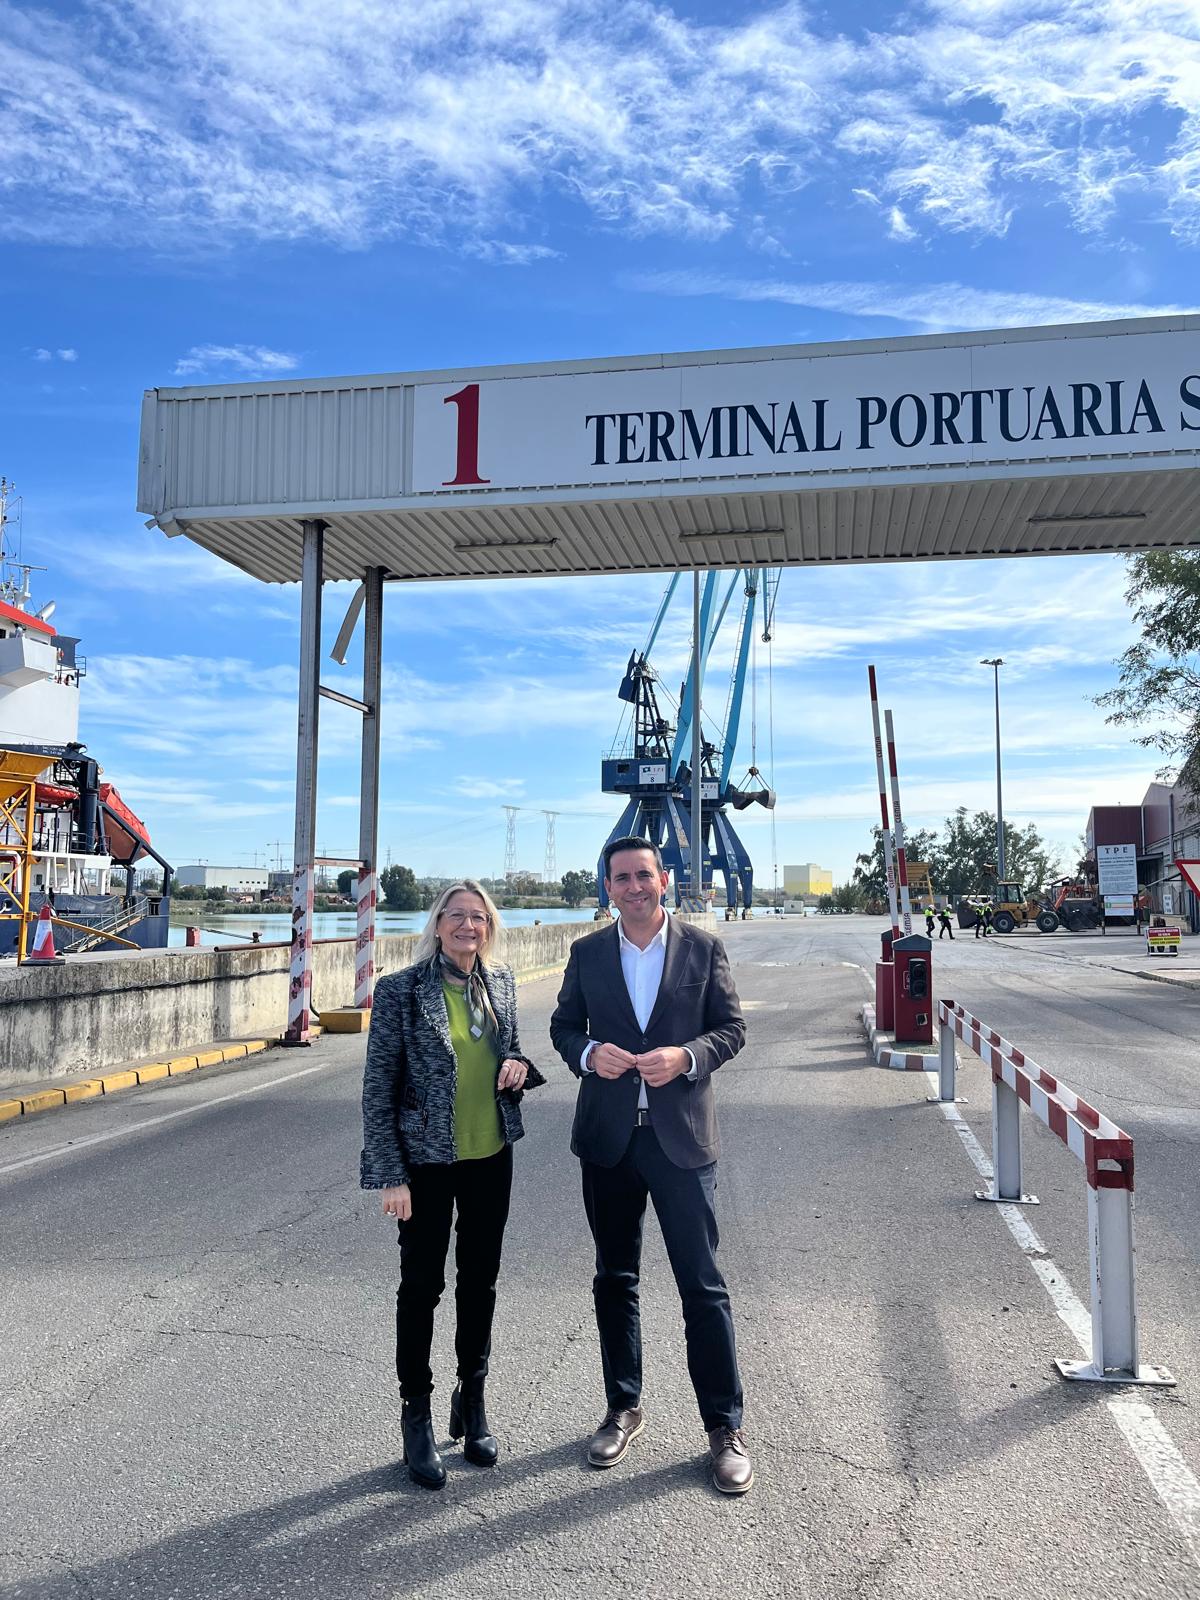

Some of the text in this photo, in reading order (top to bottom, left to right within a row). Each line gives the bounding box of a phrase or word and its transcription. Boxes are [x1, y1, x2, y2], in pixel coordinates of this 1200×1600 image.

[442, 384, 492, 486] 1
[585, 399, 842, 466] TERMINAL
[855, 378, 1166, 450] PORTUARIA
